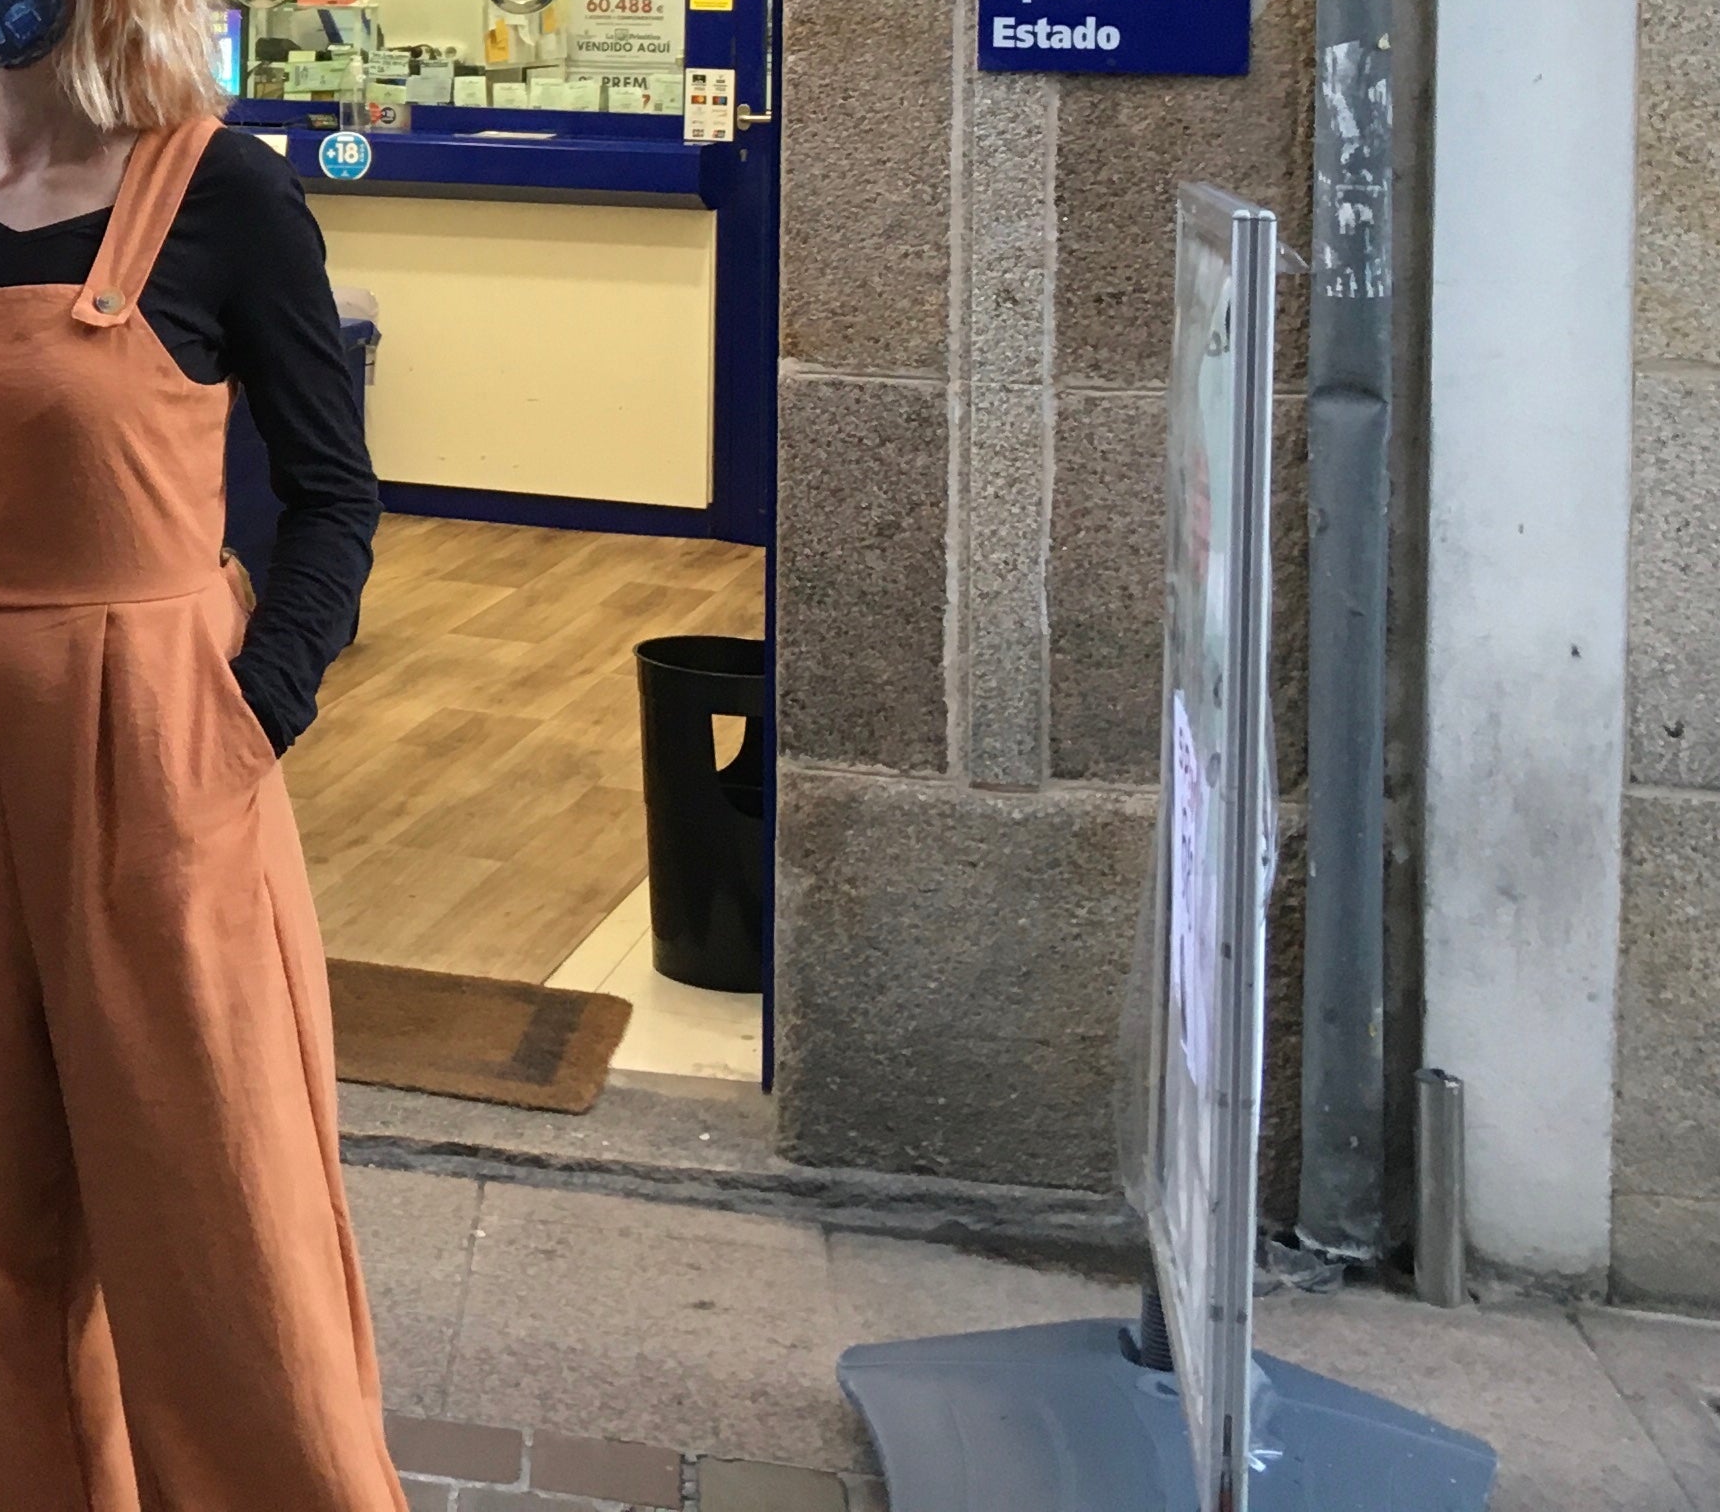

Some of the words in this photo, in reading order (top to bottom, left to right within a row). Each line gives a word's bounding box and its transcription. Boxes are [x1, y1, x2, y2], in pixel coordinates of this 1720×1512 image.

[993, 17, 1121, 51] Estado
[577, 41, 633, 53] VENDIDO
[637, 40, 671, 54] AQUÍ
[326, 142, 359, 164] +18
